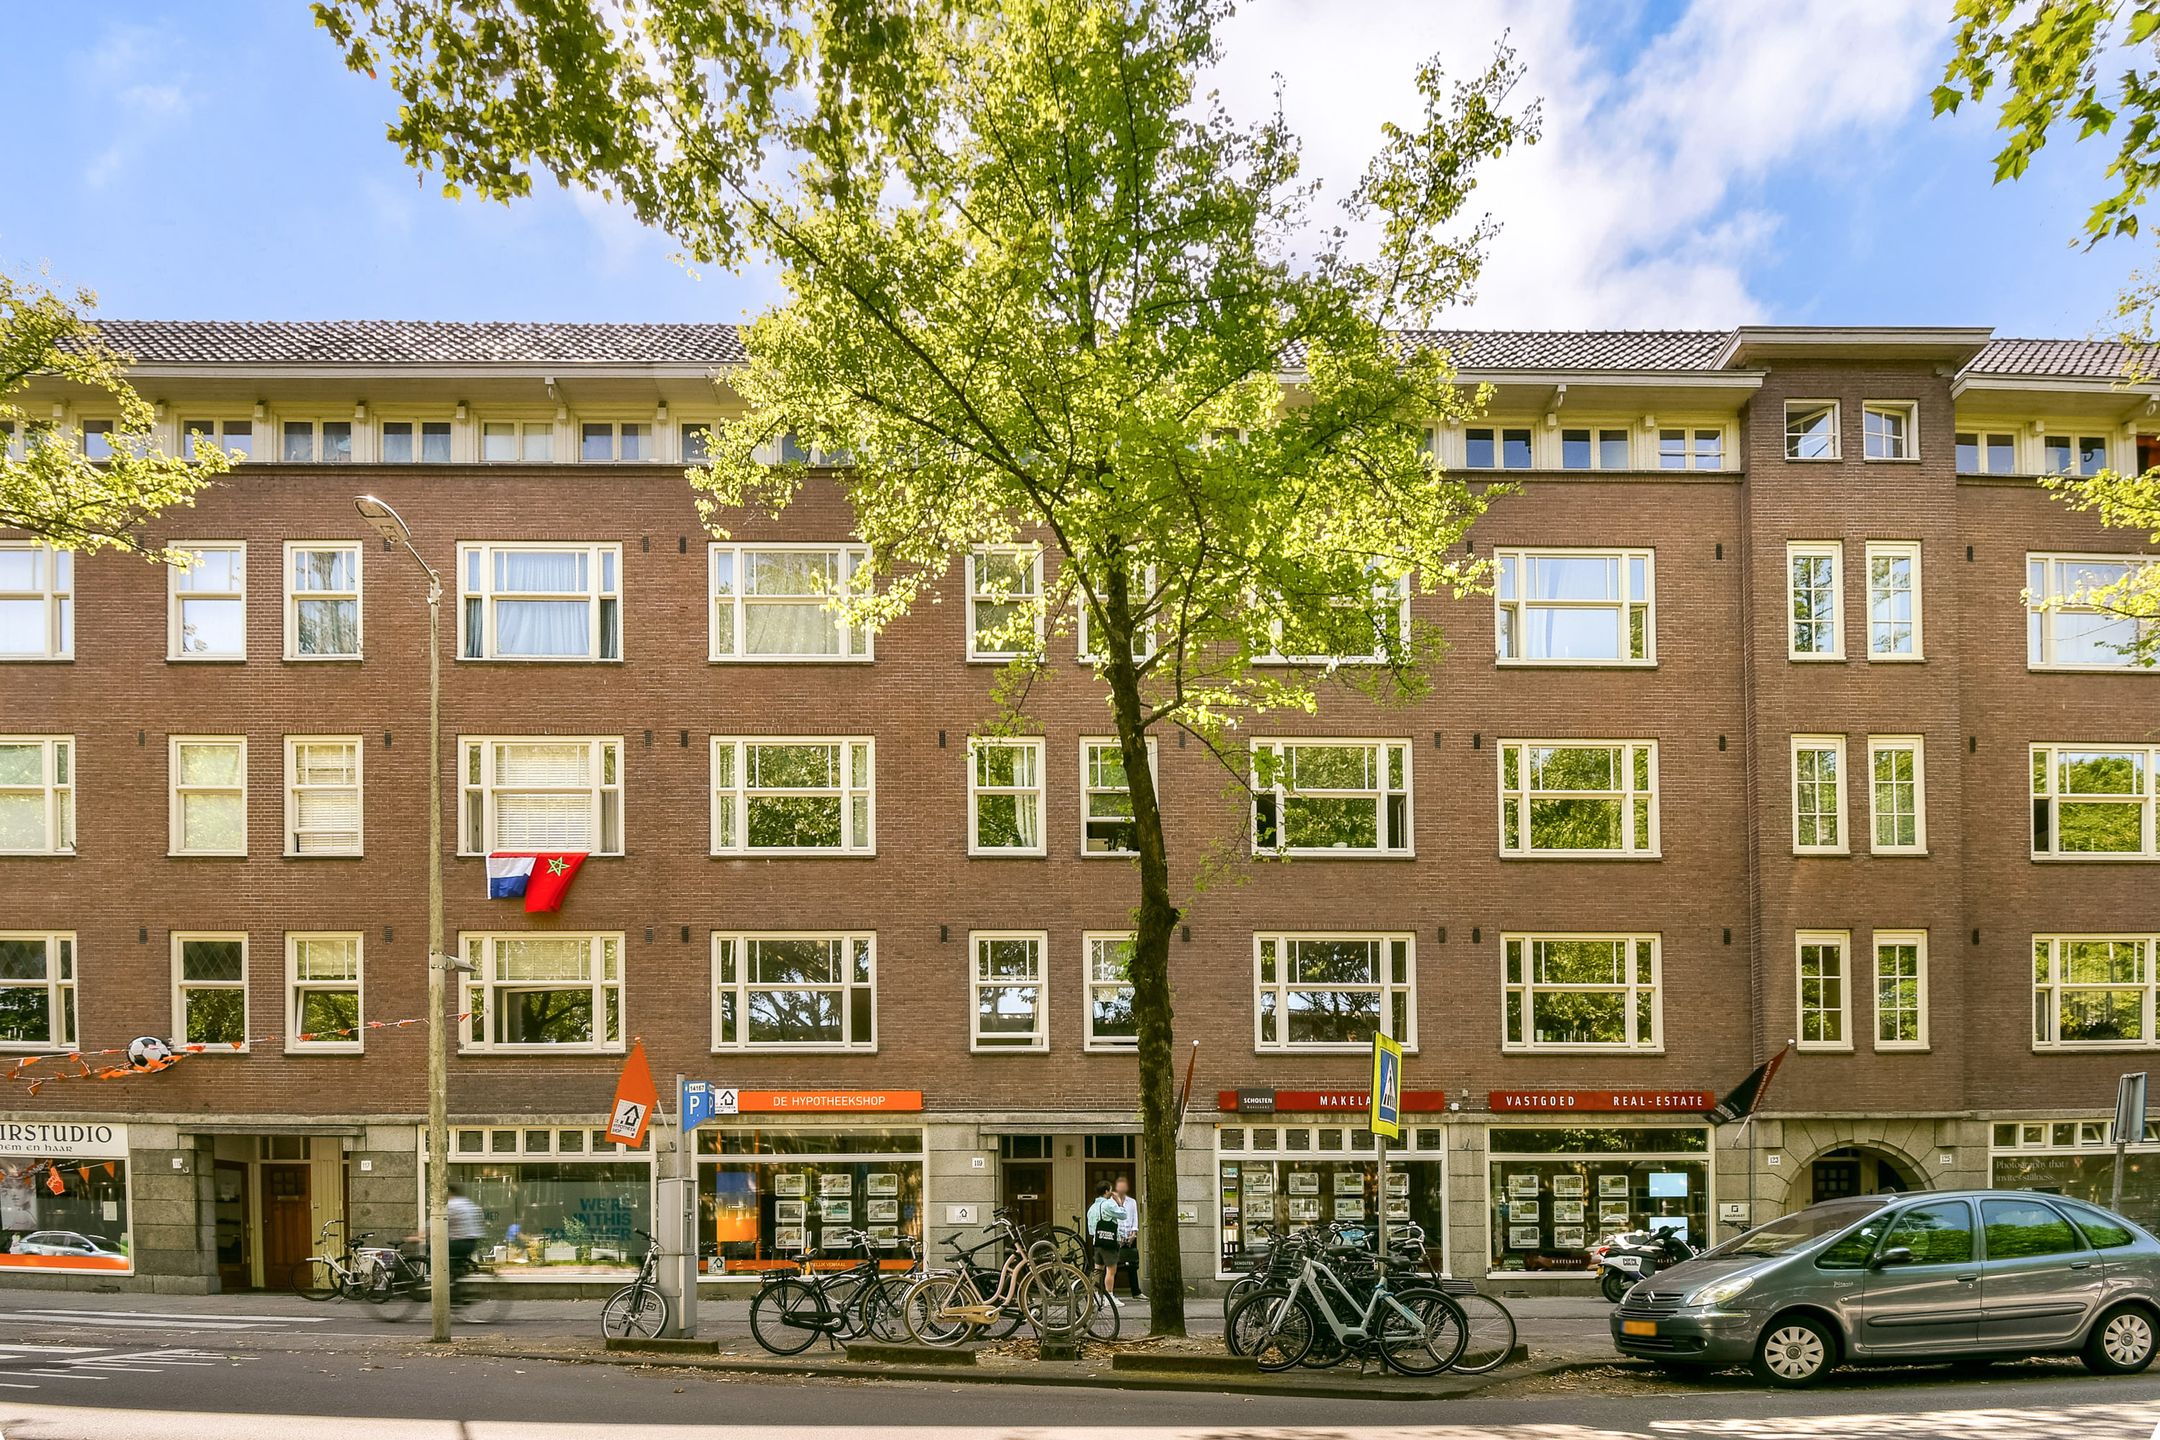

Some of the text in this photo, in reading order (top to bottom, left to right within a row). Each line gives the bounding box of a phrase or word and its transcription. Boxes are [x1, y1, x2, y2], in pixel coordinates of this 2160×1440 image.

[690, 1095, 700, 1115] P
[773, 1096, 886, 1106] DE HYPOTHEEKSHOP
[1320, 1095, 1371, 1106] MAKELA
[1506, 1096, 1703, 1106] VASTGOED REAL-ESTATE
[0, 1124, 112, 1143] IRSTUDIO
[1996, 1160, 2065, 1170] Photography that
[594, 1213, 632, 1226] THIS
